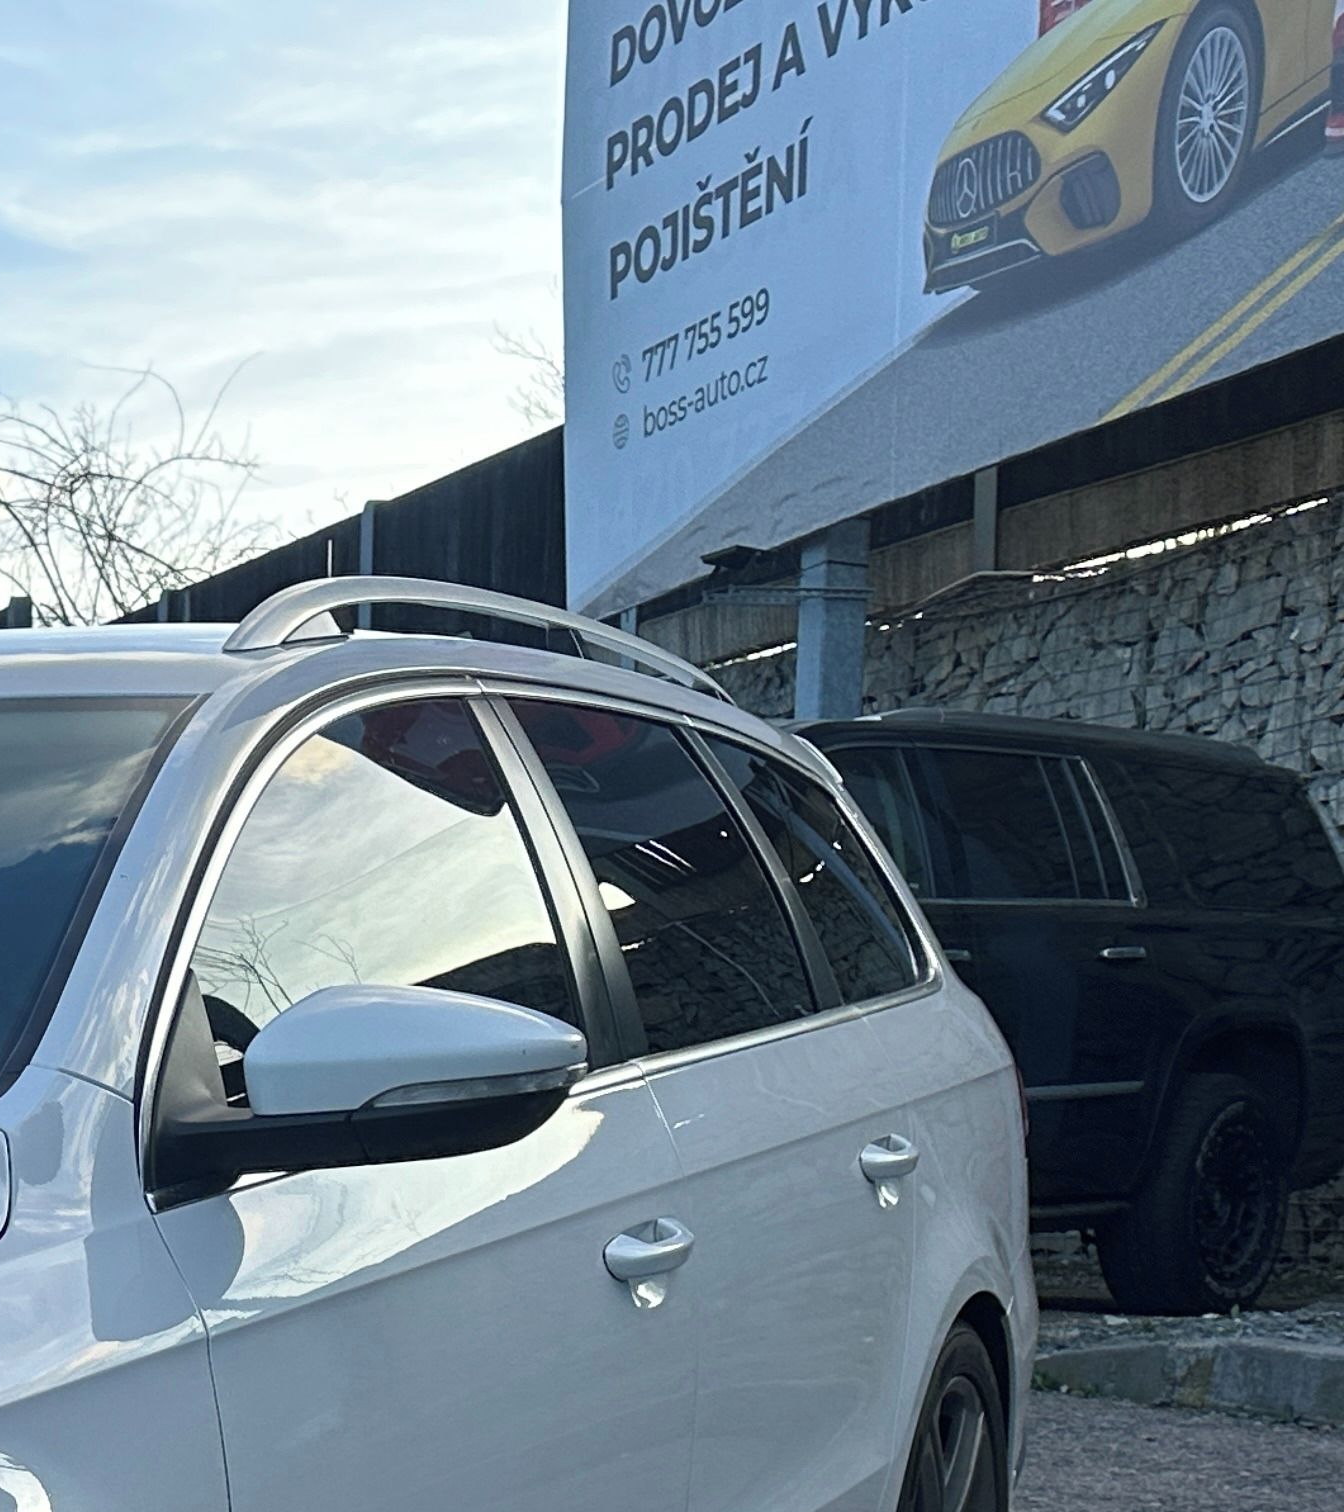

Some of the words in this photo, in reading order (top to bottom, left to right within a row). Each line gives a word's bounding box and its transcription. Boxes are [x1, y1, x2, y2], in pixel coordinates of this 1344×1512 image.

[610, 0, 744, 87] DOV
[606, 42, 762, 190] PRODEJ
[772, 22, 806, 92] A
[610, 115, 814, 300] POJIŠTĚNÍ
[642, 333, 679, 383] 777
[684, 312, 721, 360] 755
[727, 288, 770, 339] 599
[644, 355, 768, 438] boss-auto.cz
